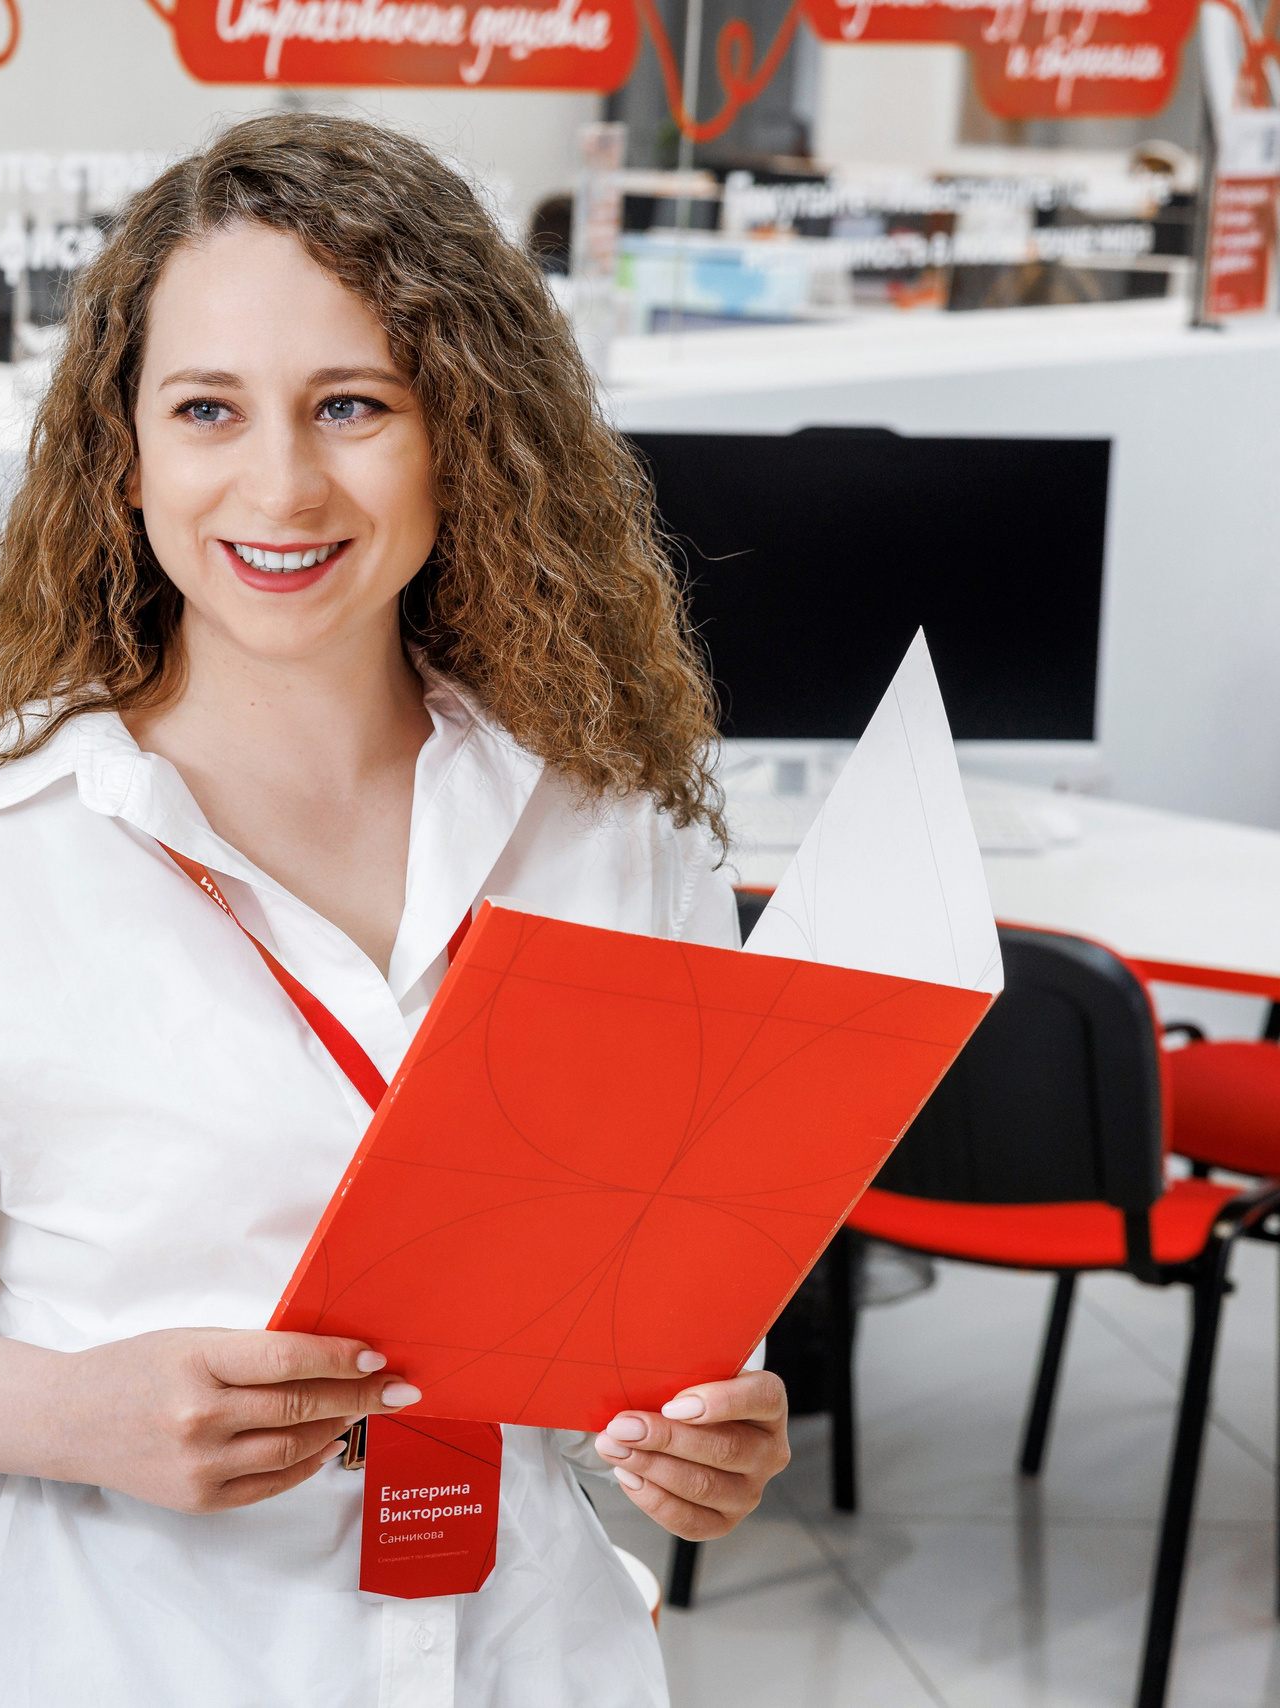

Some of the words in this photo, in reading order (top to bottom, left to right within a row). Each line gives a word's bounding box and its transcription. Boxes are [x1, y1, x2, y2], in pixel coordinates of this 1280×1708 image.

[380, 1483, 471, 1502] Екатерина
[379, 1503, 483, 1524] Викторовна
[379, 1530, 444, 1545] Санникова
